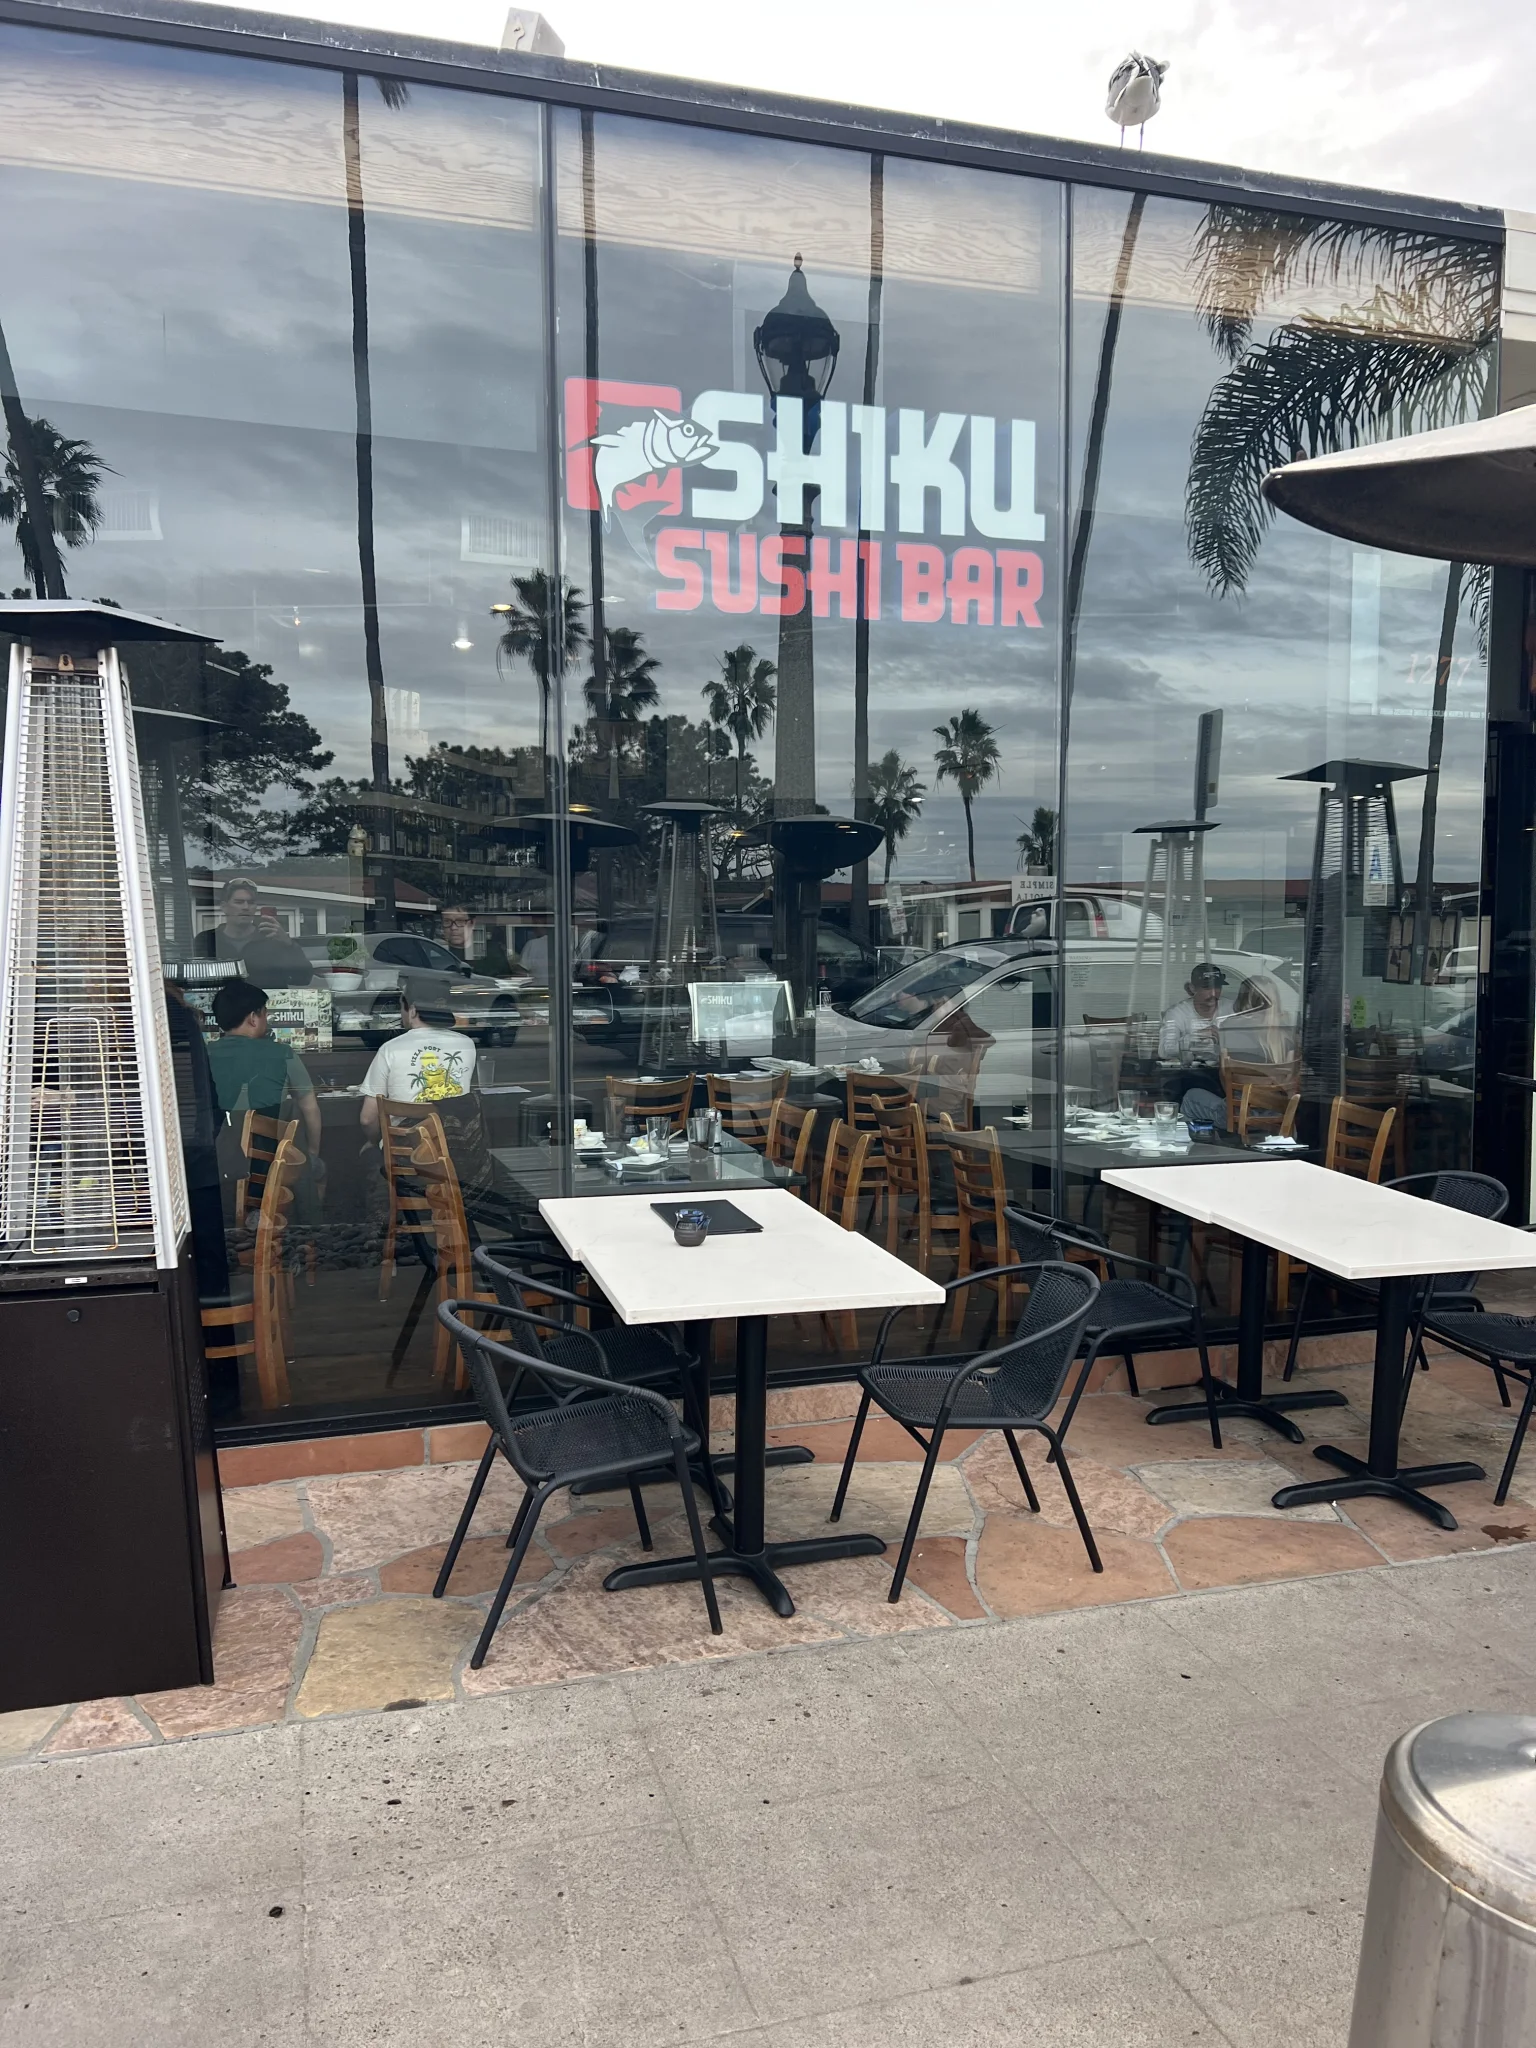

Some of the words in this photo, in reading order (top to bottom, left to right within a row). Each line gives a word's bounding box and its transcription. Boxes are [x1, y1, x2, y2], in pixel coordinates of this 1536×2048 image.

[692, 389, 1046, 542] SHIKU
[655, 528, 883, 621] SUSHI
[896, 541, 1045, 629] BAR
[1405, 653, 1472, 687] 1277
[707, 995, 733, 1005] SHIKU
[273, 1011, 304, 1022] SHIKU
[410, 1049, 423, 1067] PIZZA
[423, 1045, 441, 1053] PORT
